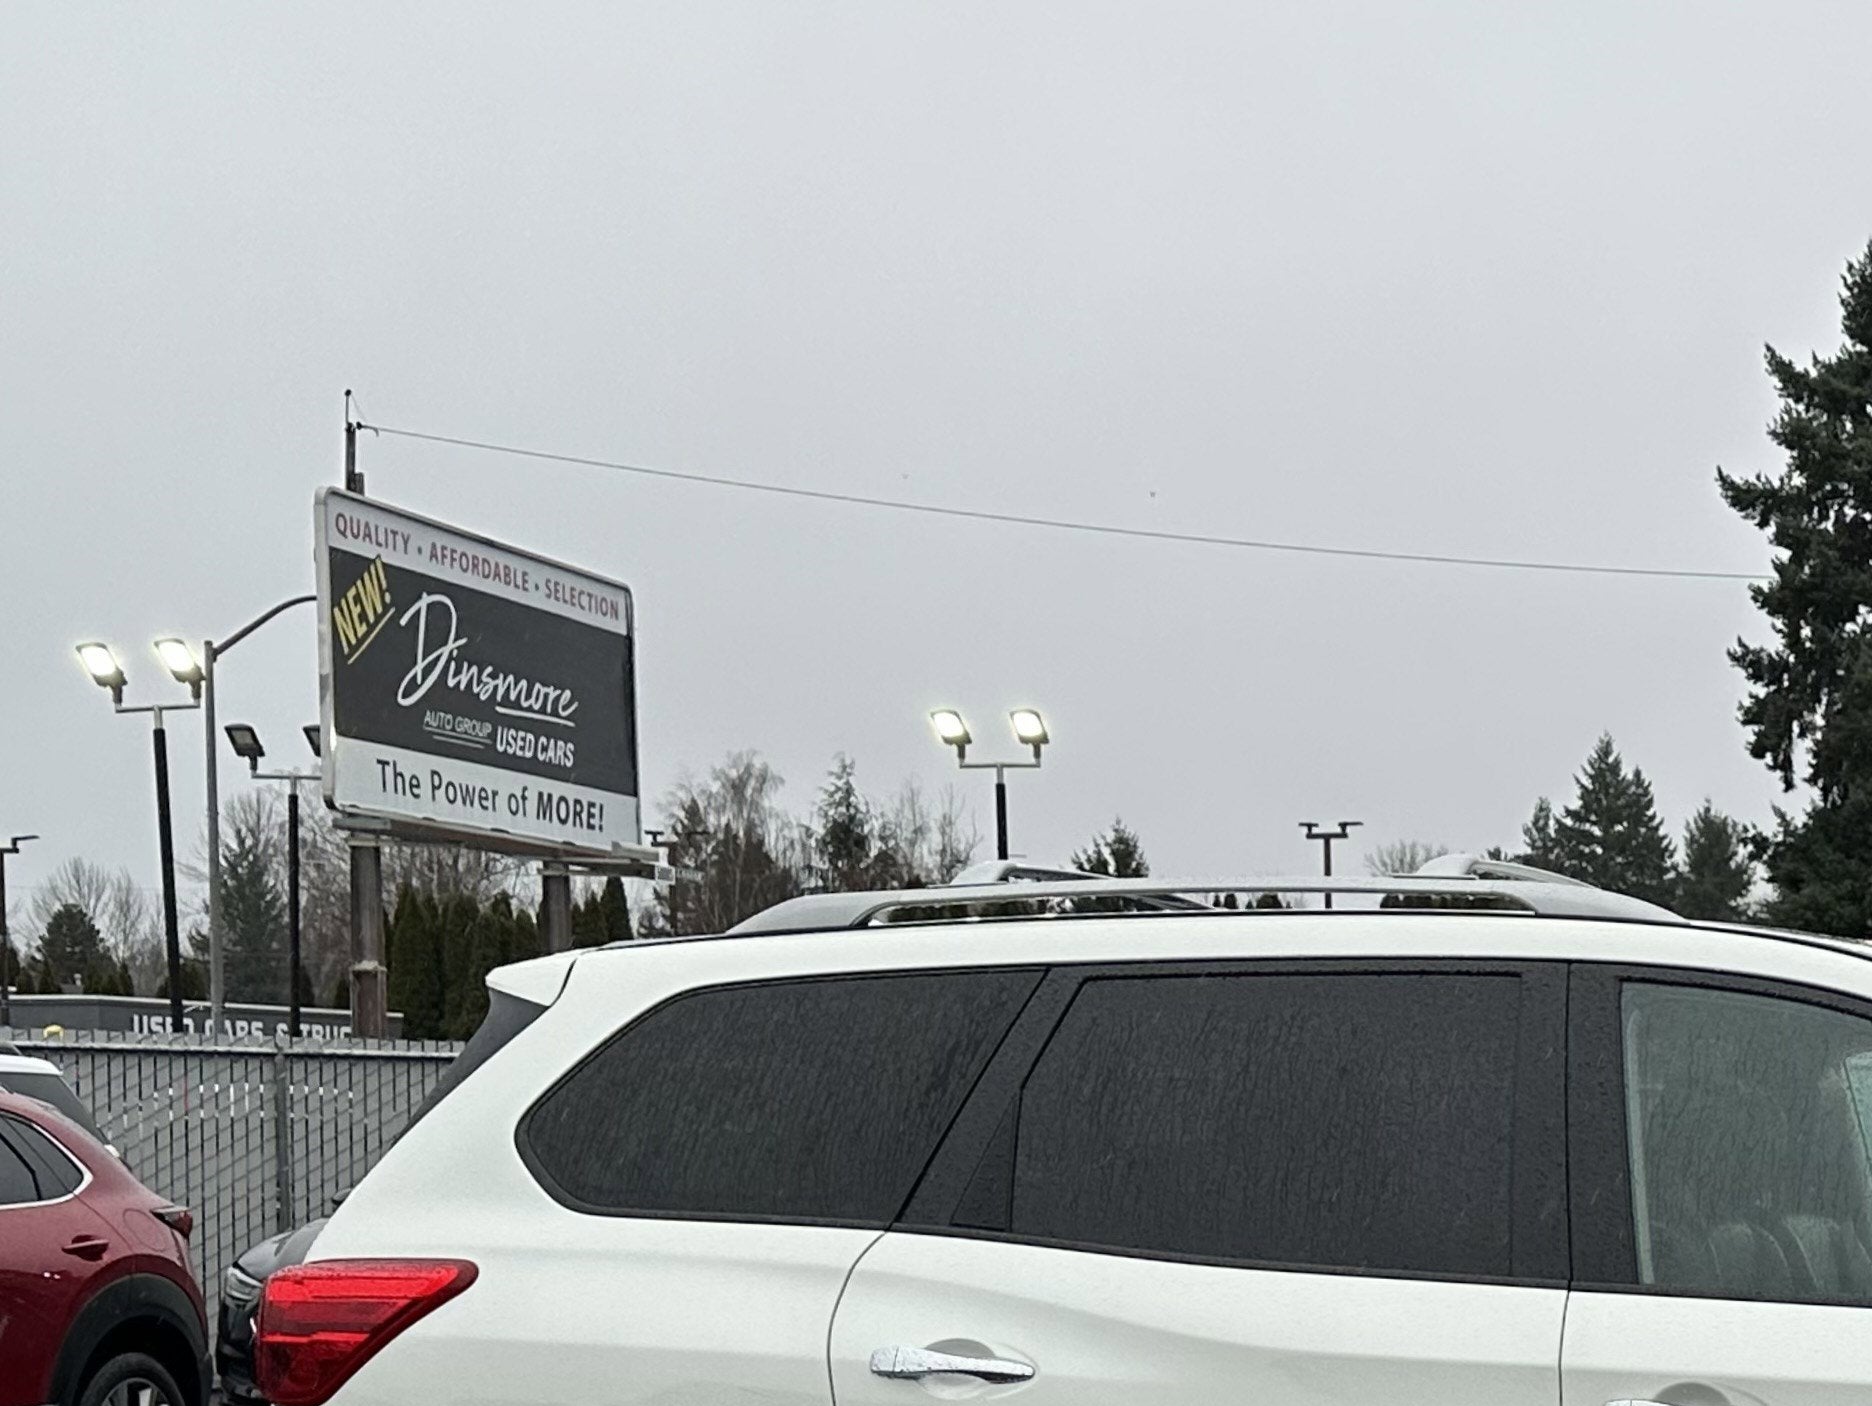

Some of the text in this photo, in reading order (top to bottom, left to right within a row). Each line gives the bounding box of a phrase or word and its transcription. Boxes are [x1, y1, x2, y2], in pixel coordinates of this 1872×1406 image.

[333, 554, 391, 655] NEW!
[335, 512, 620, 621] QUALITY AFFORDABLE SELECTION
[397, 592, 579, 717] Dinsmore
[423, 710, 493, 738] AUTO GROUP
[496, 725, 575, 768] USED CARS
[376, 758, 604, 833] The Power of MORE!
